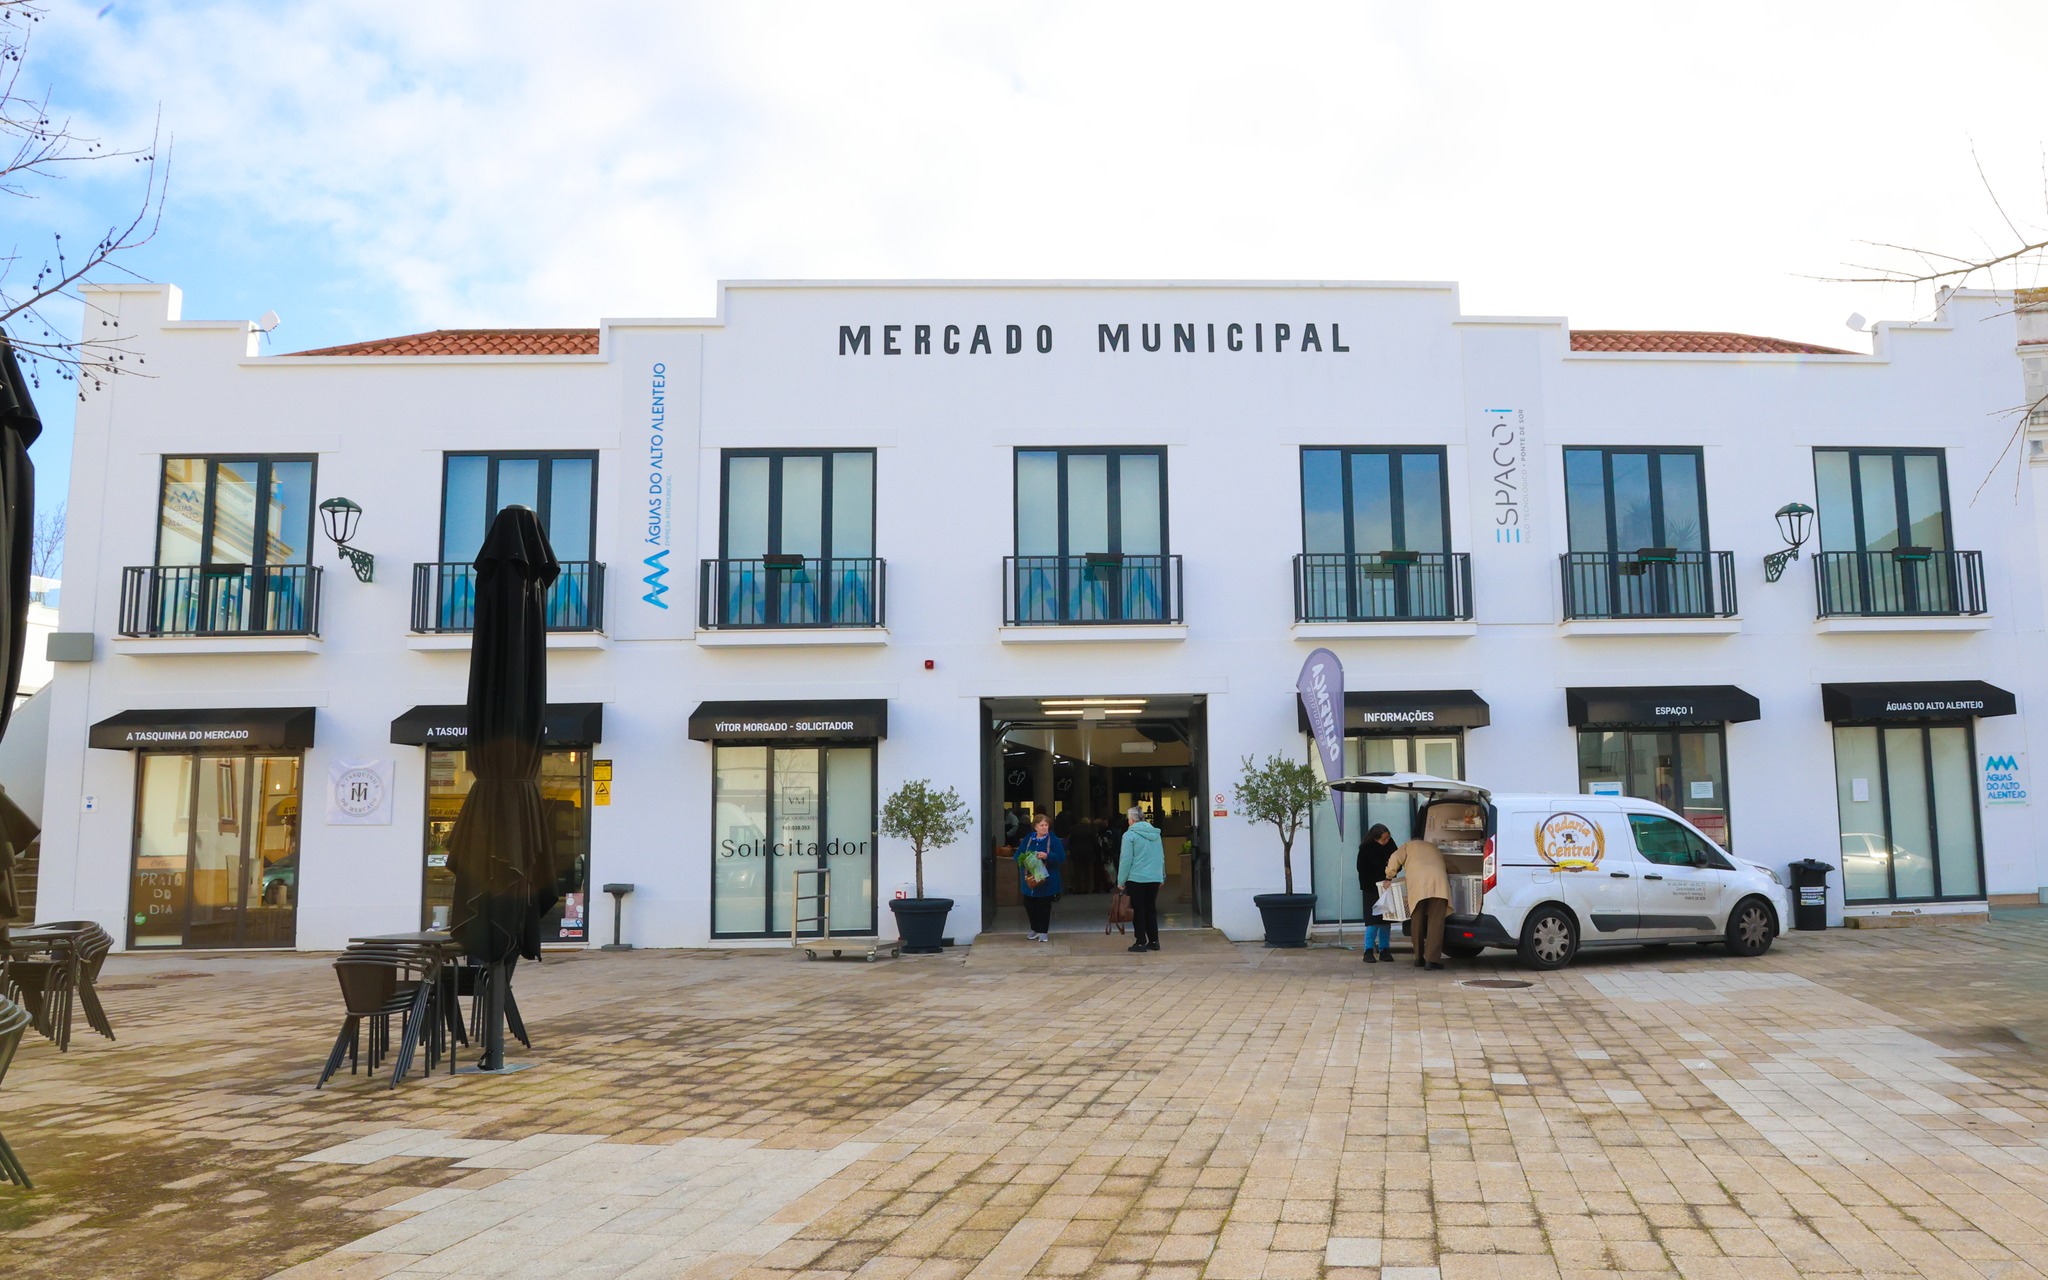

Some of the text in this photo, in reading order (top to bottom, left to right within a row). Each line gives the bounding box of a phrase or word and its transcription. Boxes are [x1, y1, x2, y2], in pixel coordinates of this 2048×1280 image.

[839, 322, 1350, 355] MERCADO MUNICIPAL
[1519, 425, 1525, 435] DE
[645, 363, 666, 546] ÁGUAS DO ALTO ALENTEJO
[1655, 706, 1688, 716] ESPAÇO
[1886, 701, 1984, 711] ÁGUAS DO ALTO ALENTEJO
[1364, 710, 1435, 723] INFORMAÇÕES
[427, 727, 468, 737] A TASQUI
[715, 721, 741, 732] VÍTOR
[743, 722, 788, 732] MORGADO
[796, 721, 854, 731] SOLICITADOR
[126, 730, 249, 742] A TASQUINHA DO MERCADO
[1986, 772, 2013, 782] ÁGUAS
[1986, 782, 2020, 791] DO ALTO
[1988, 790, 2027, 799] ALENTEJO
[1547, 816, 1591, 838] Padaria
[721, 838, 868, 858] Solicitador
[1547, 840, 1595, 858] Central
[149, 904, 173, 915] DIA
